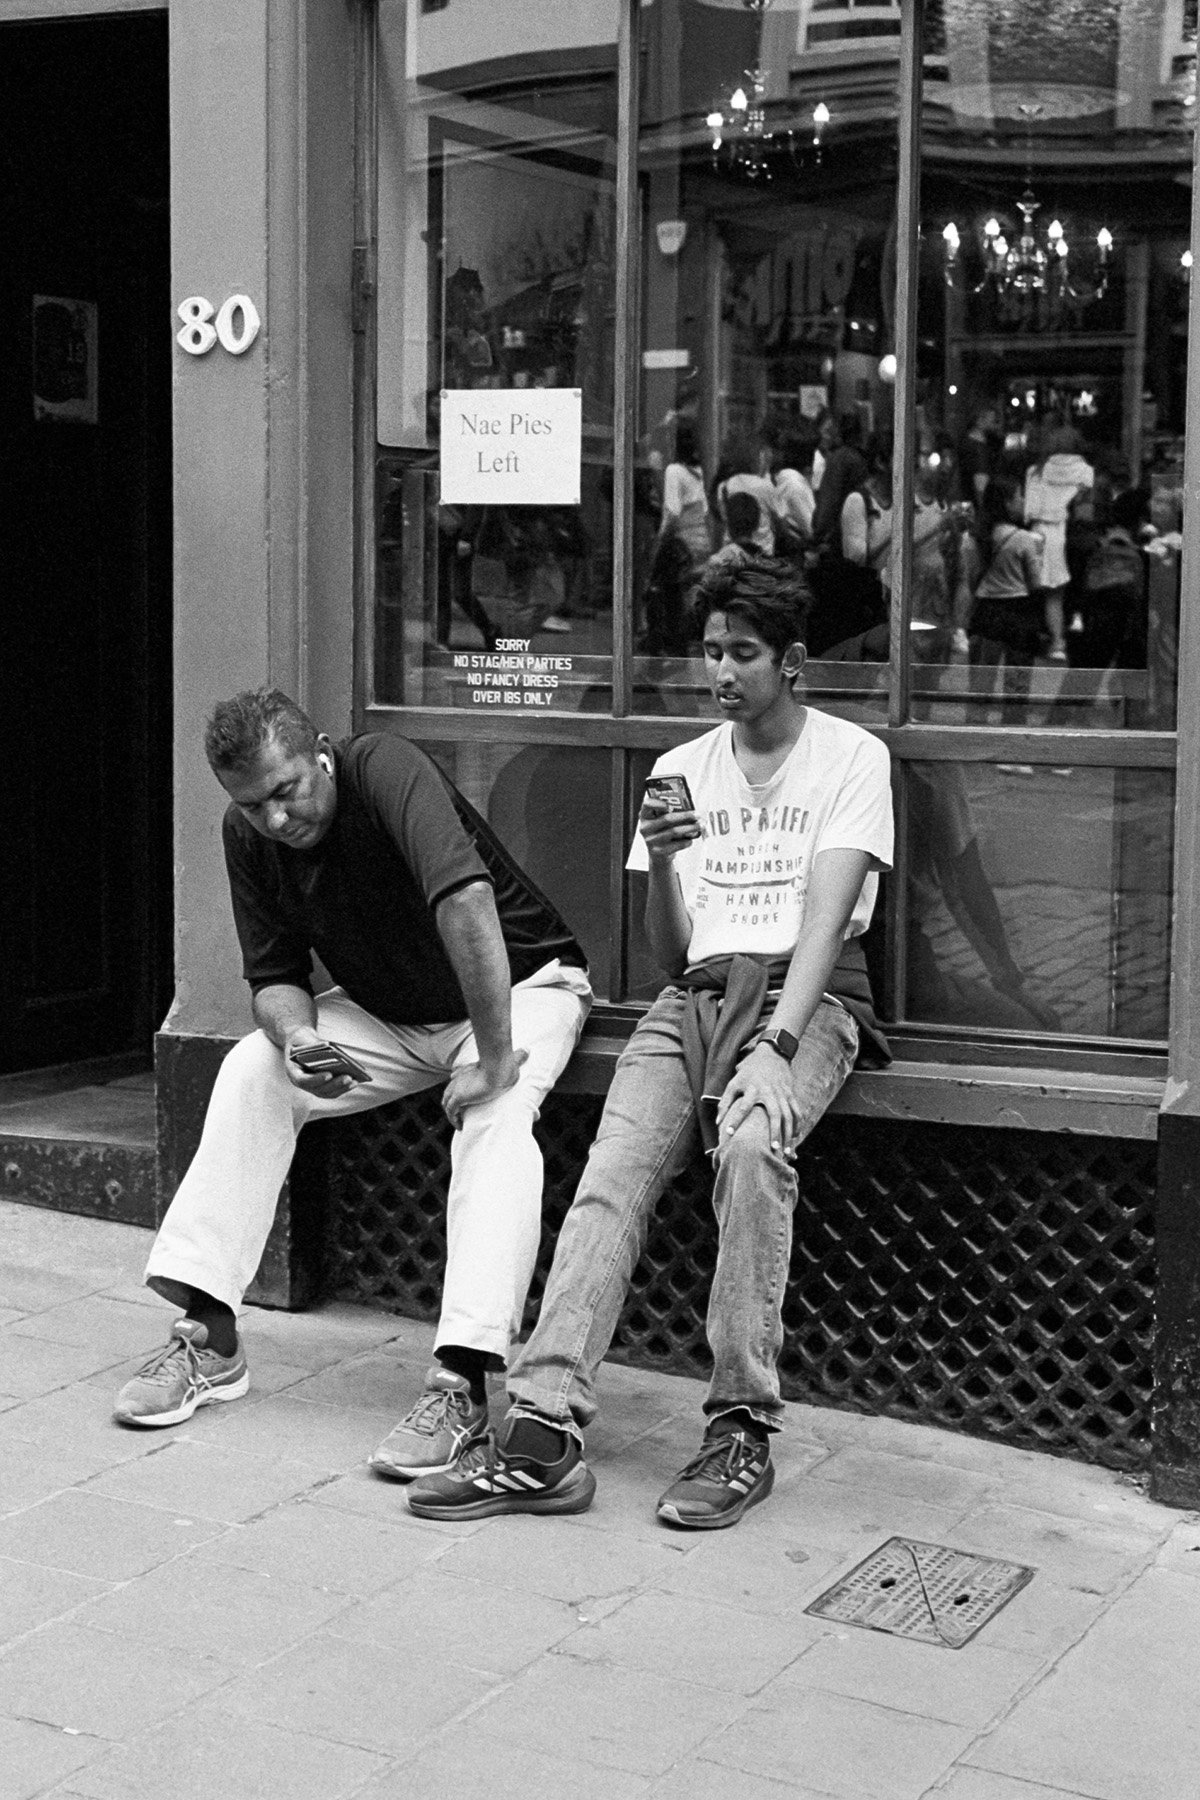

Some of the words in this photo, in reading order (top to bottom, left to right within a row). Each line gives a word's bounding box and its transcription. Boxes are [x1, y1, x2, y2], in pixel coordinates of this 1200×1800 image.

[177, 294, 260, 355] 80
[460, 413, 501, 435] Nae
[510, 412, 552, 435] Pies
[477, 451, 520, 473] Left
[495, 638, 531, 652] SORRY
[453, 655, 469, 668] NO
[471, 655, 524, 670] STAG/HEN
[526, 656, 572, 671] PARTIES
[467, 672, 482, 686] NO
[484, 672, 520, 687] FANCY
[522, 673, 559, 688] DRESS
[472, 690, 501, 704] OVER
[523, 692, 553, 705] ONLY
[740, 805, 812, 834] PAIFI
